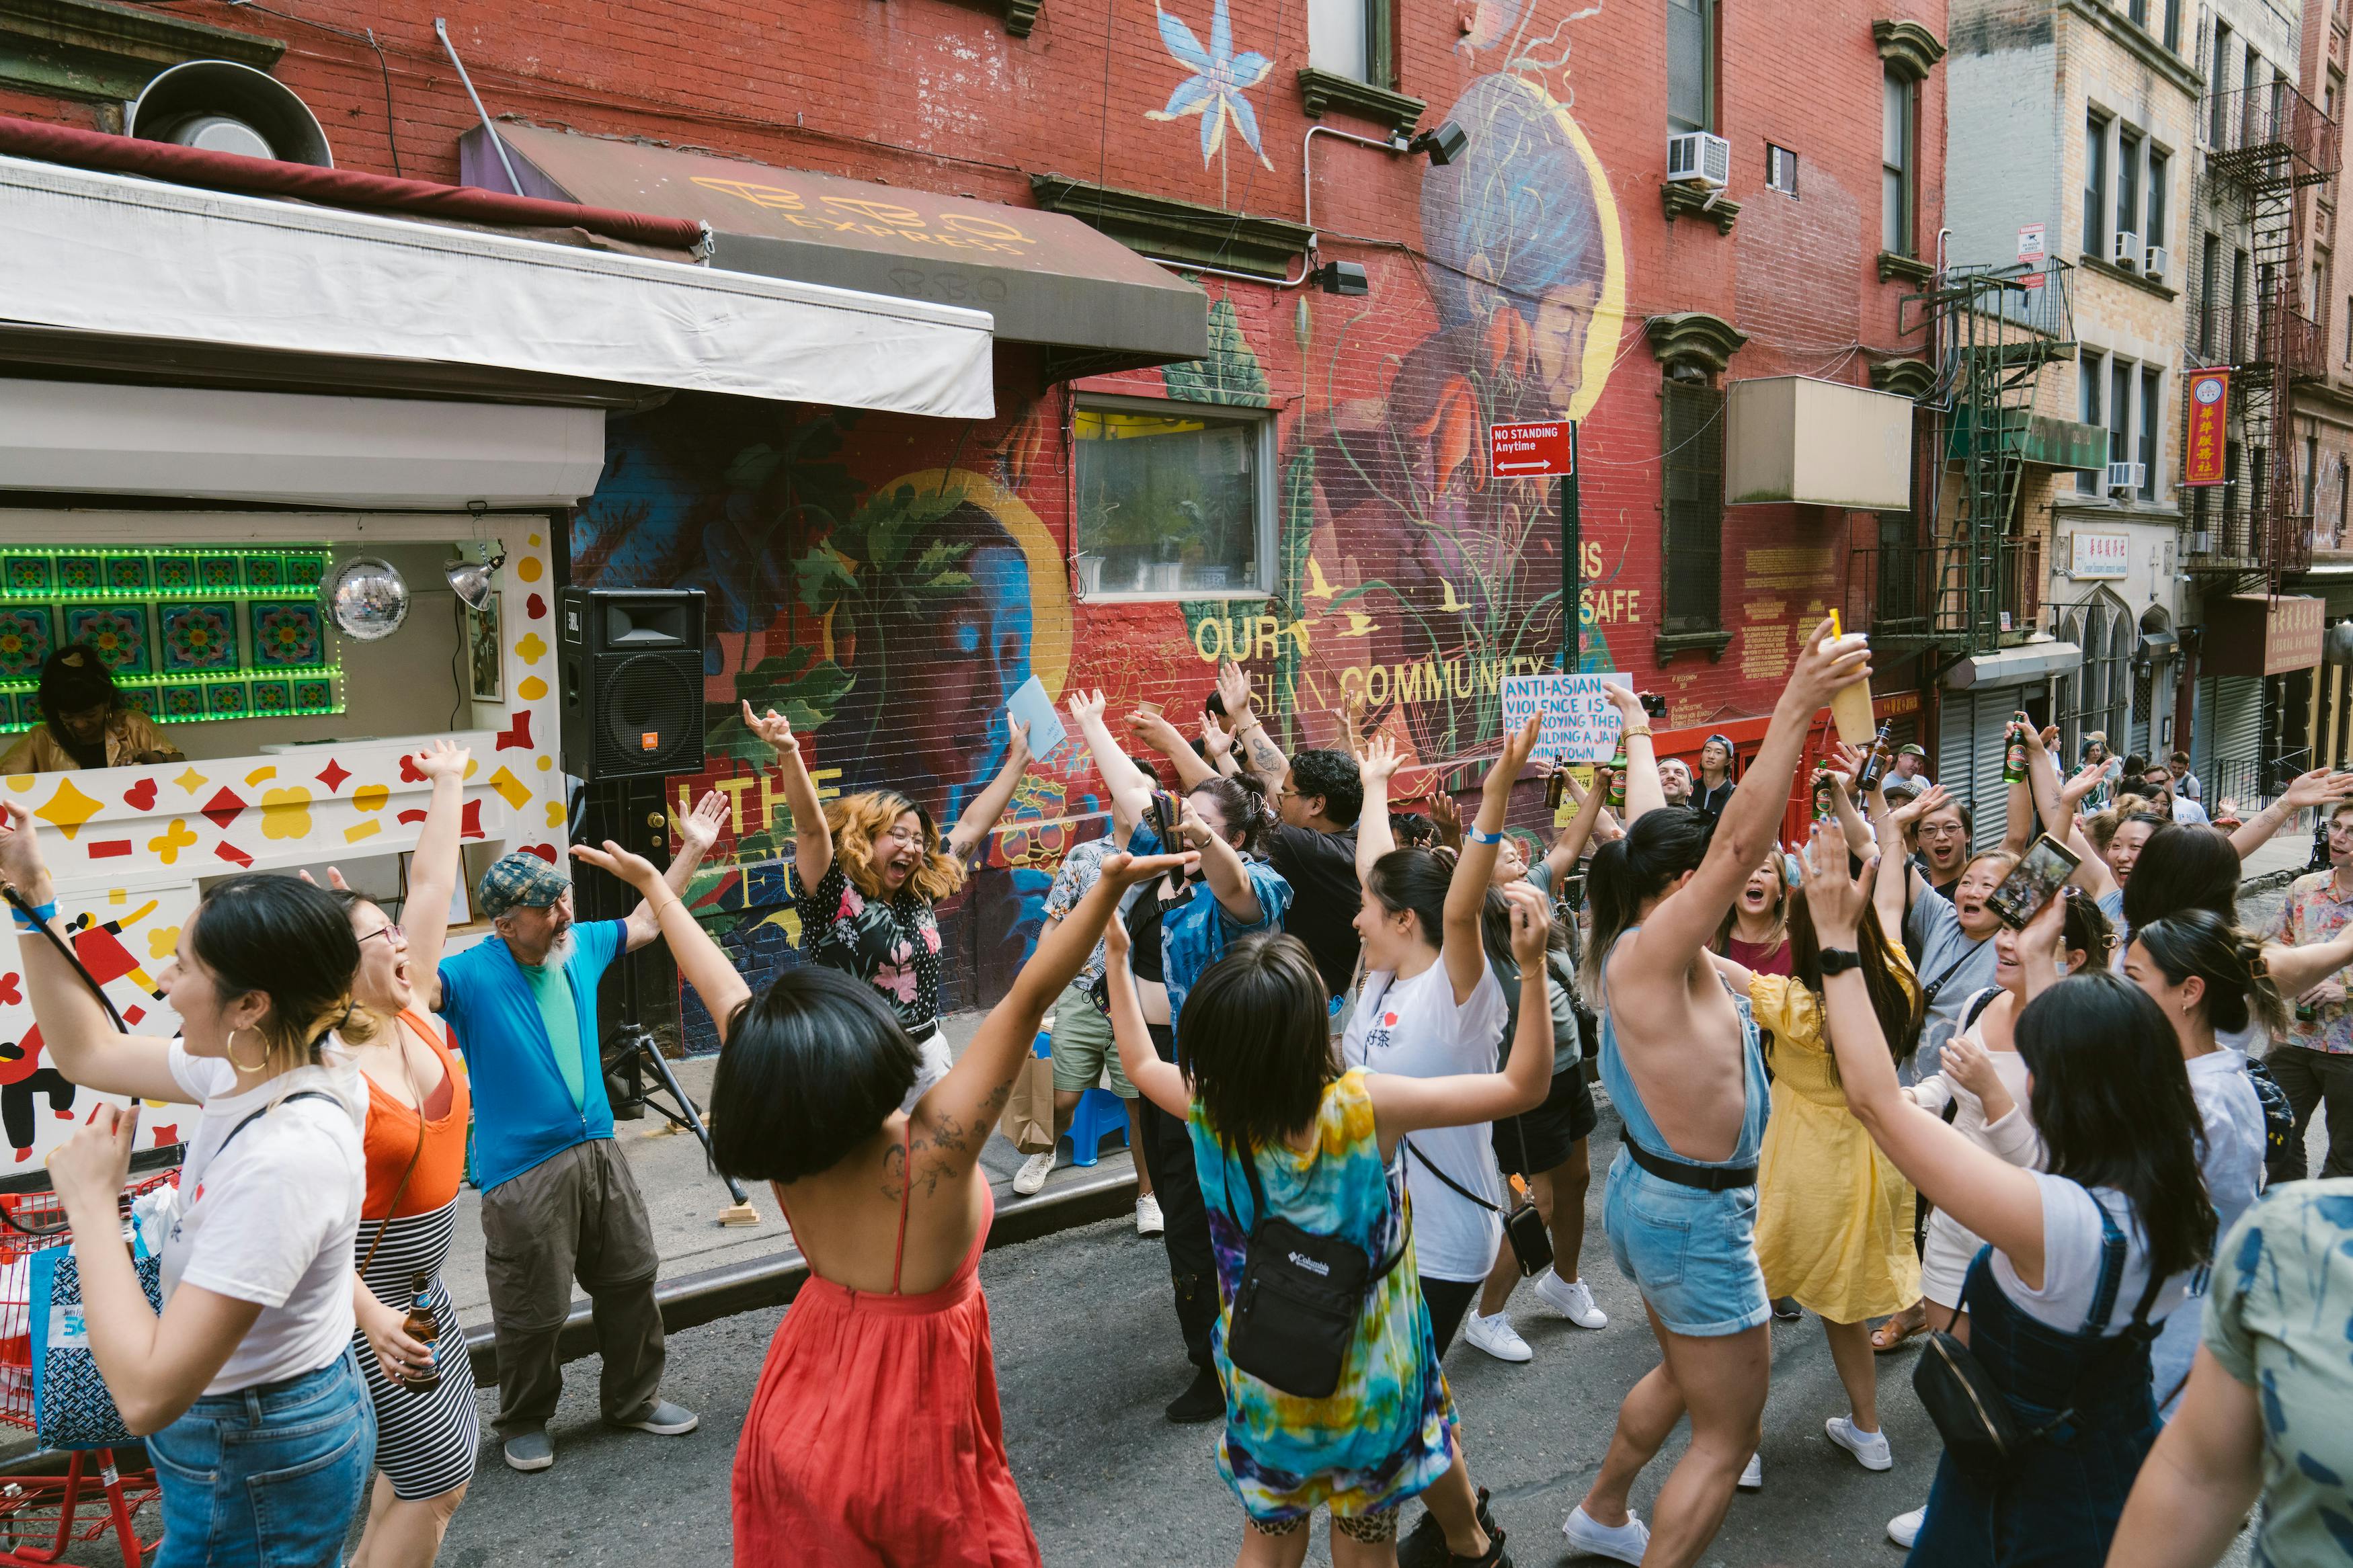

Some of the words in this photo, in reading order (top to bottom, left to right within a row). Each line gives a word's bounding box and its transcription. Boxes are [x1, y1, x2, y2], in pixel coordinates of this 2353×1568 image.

[782, 213, 1026, 255] EXPRESS
[1494, 429, 1509, 440] NO
[1511, 427, 1558, 440] STANDING
[1496, 441, 1536, 454] Anytime
[1581, 541, 1602, 578] IS
[1579, 588, 1640, 624] SAFE
[568, 612, 579, 632] JBL
[1196, 616, 1279, 662] OUR
[1250, 670, 1328, 716] SIAN
[1340, 655, 1545, 708] COMMUNITY
[1505, 677, 1601, 699] ANTI-ASIAN
[1506, 699, 1579, 714] VIOLENCE
[1587, 698, 1604, 712] IS
[1505, 714, 1586, 730] DESROYING
[1505, 731, 1580, 745] UILDING
[1583, 731, 1592, 744] A
[1529, 746, 1595, 760] HINATOWN
[1298, 1253, 1329, 1271] Columbia
[422, 1366, 438, 1374] ELGIAN
